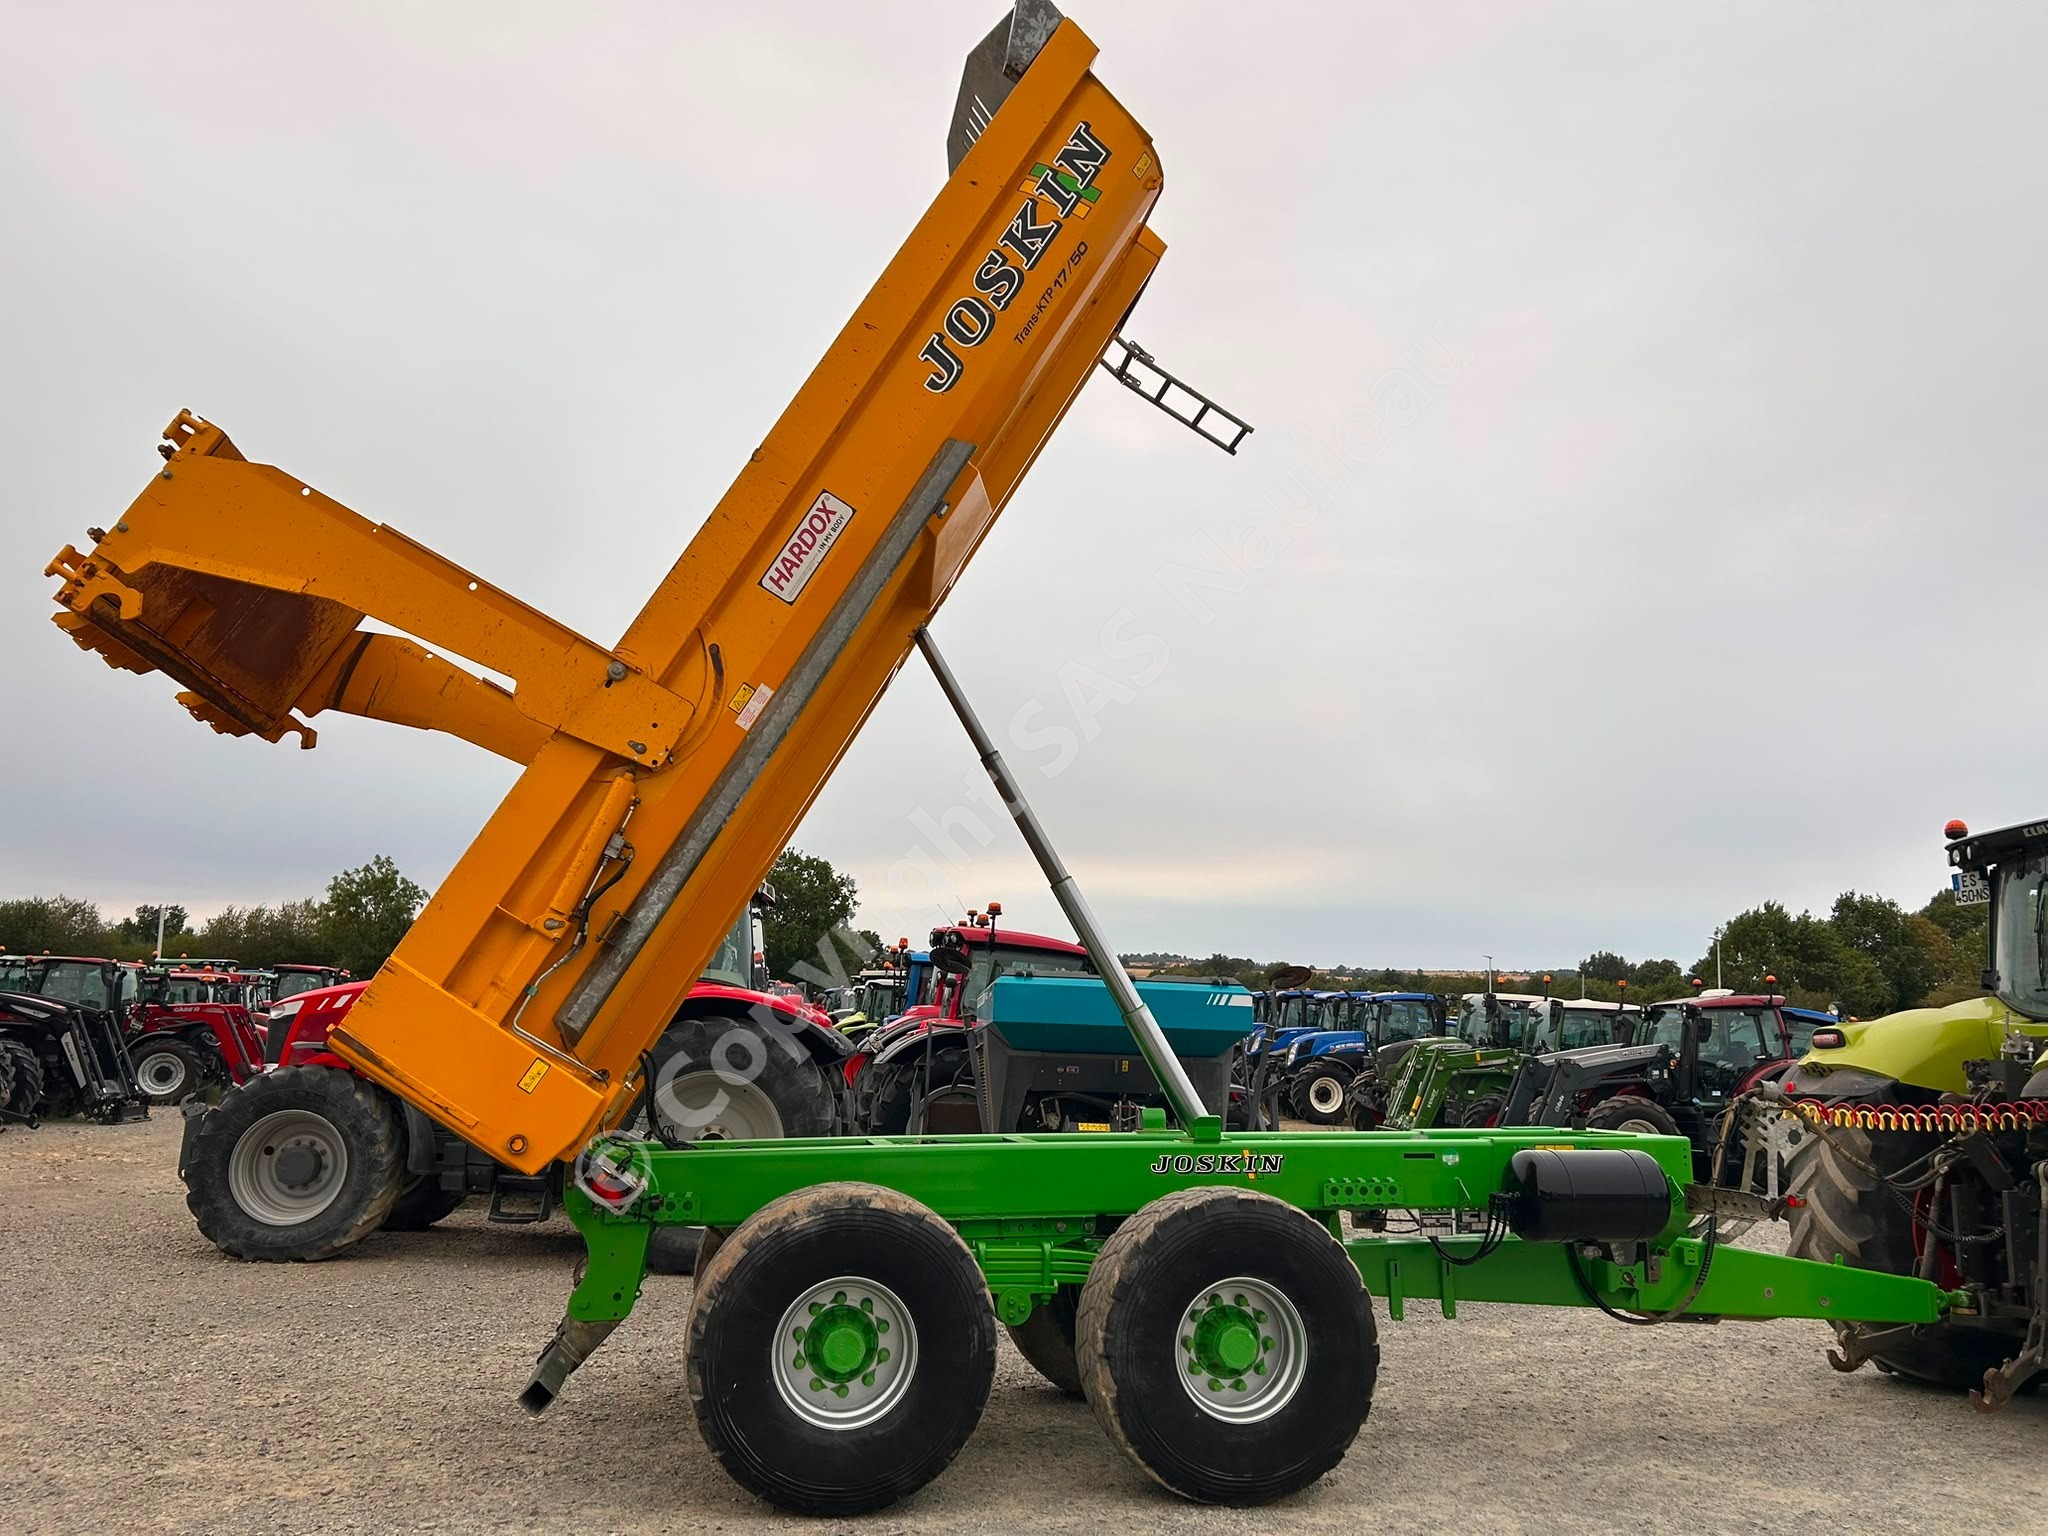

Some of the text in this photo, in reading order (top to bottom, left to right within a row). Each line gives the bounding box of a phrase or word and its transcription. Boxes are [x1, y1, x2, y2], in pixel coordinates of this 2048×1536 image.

[918, 121, 1112, 394] JOSKIN
[1014, 240, 1088, 346] Trans-KTP 17/50
[768, 500, 837, 592] HARDOX
[824, 532, 834, 544] MY
[830, 514, 845, 533] BODY
[1956, 887, 1990, 903] 450-NS
[1151, 1154, 1284, 1175] JOSKIN
